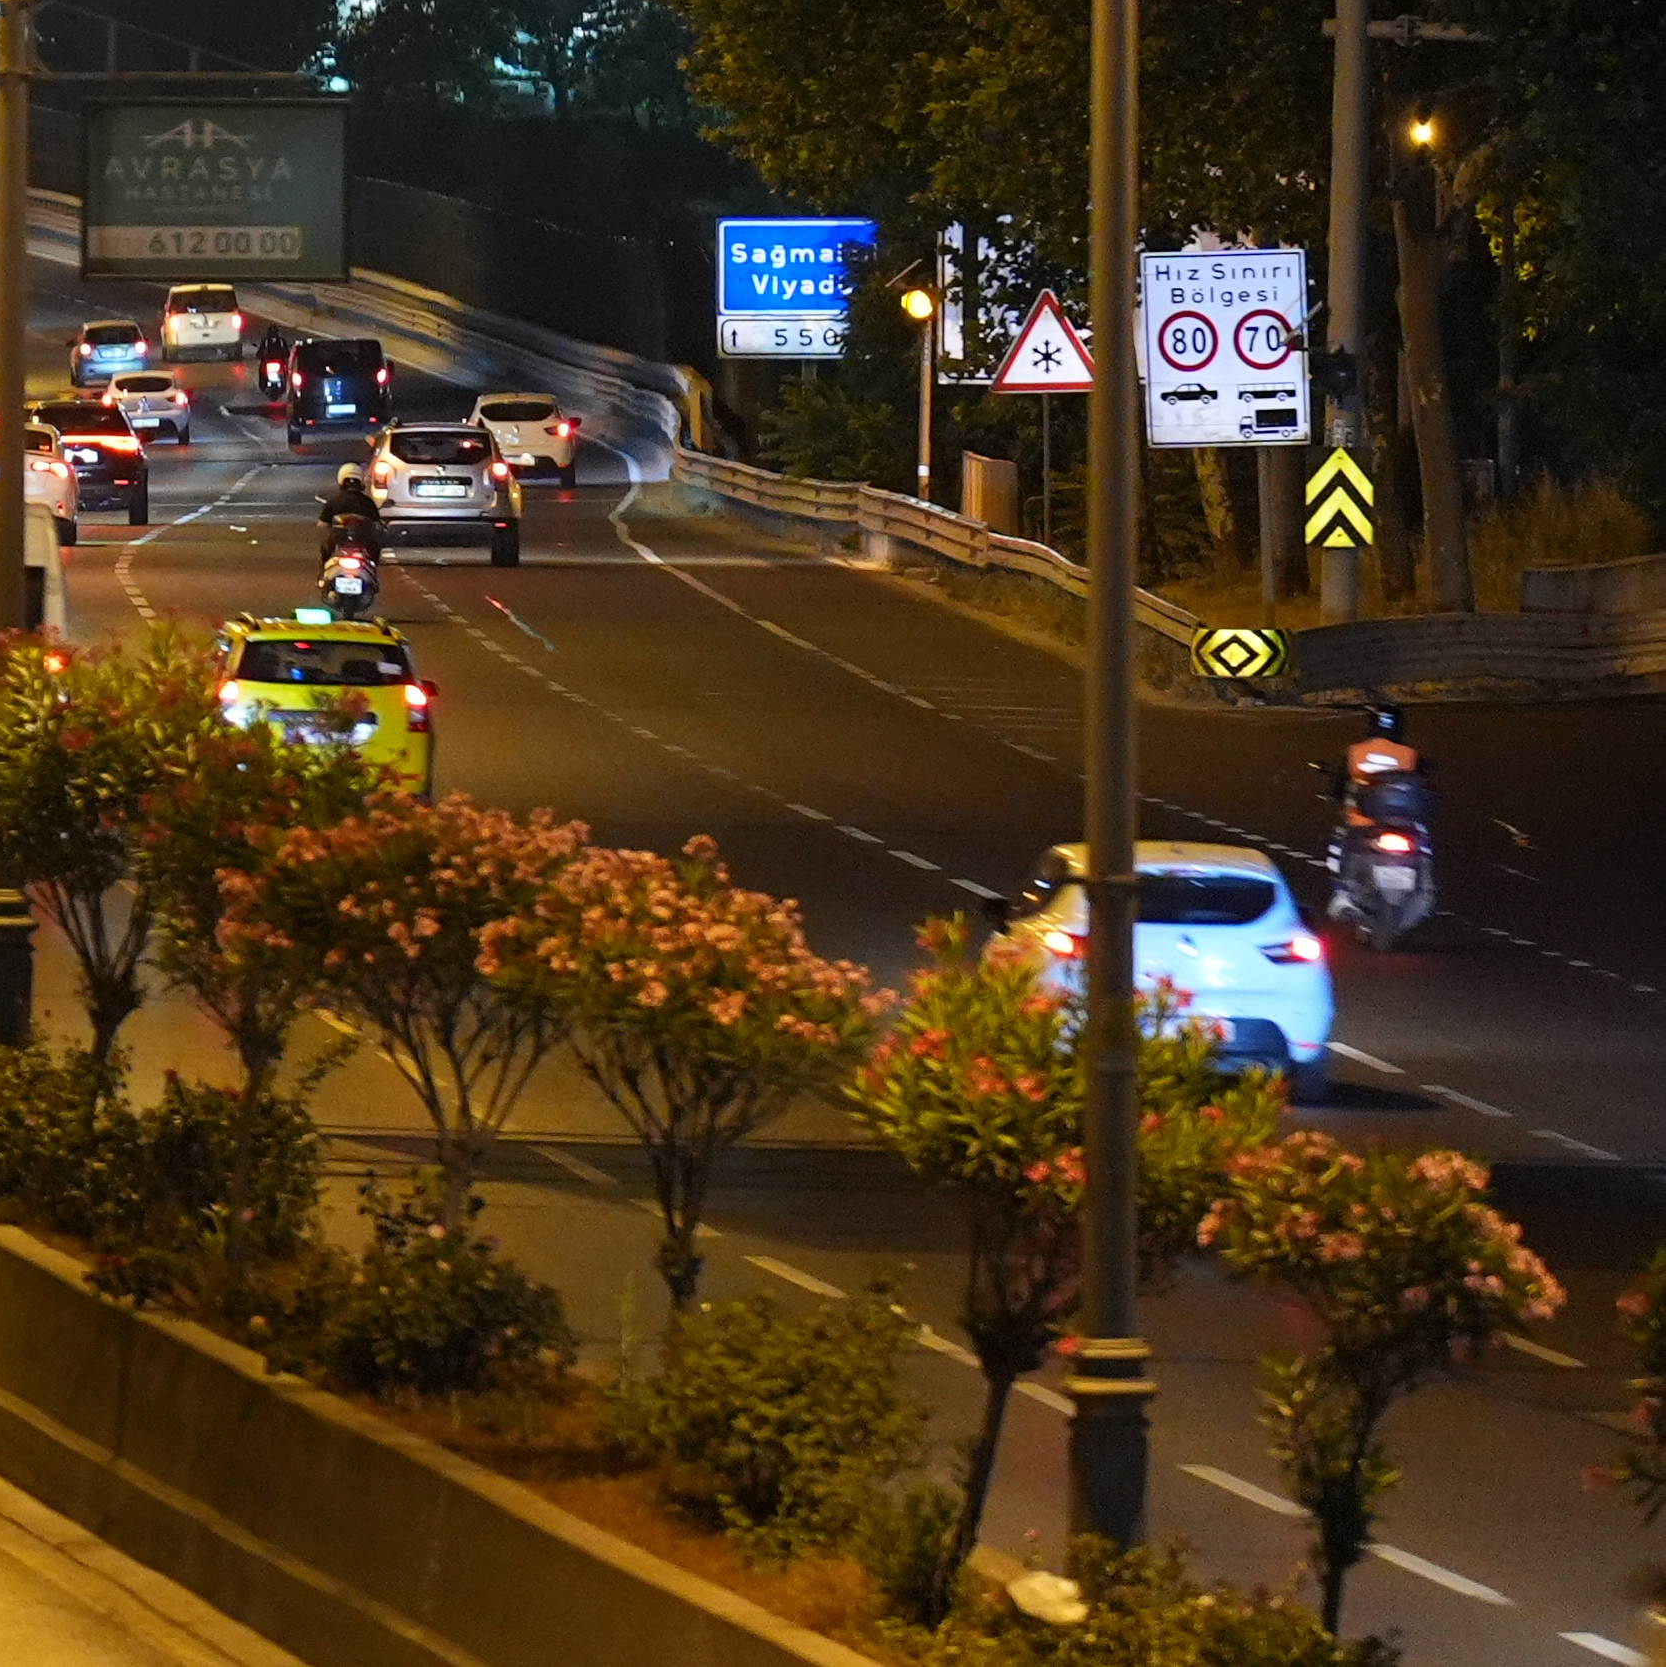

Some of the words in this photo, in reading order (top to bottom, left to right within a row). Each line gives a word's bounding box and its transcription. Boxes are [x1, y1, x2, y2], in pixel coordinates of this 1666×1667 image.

[104, 156, 292, 181] AVRASYA
[149, 231, 207, 254] 612
[730, 243, 843, 268] Sağmal
[1155, 264, 1200, 281] Hız
[1211, 263, 1291, 280] Sınırı
[1171, 286, 1278, 307] Bölgesi
[1172, 327, 1206, 355] 80
[1244, 324, 1280, 352] 70
